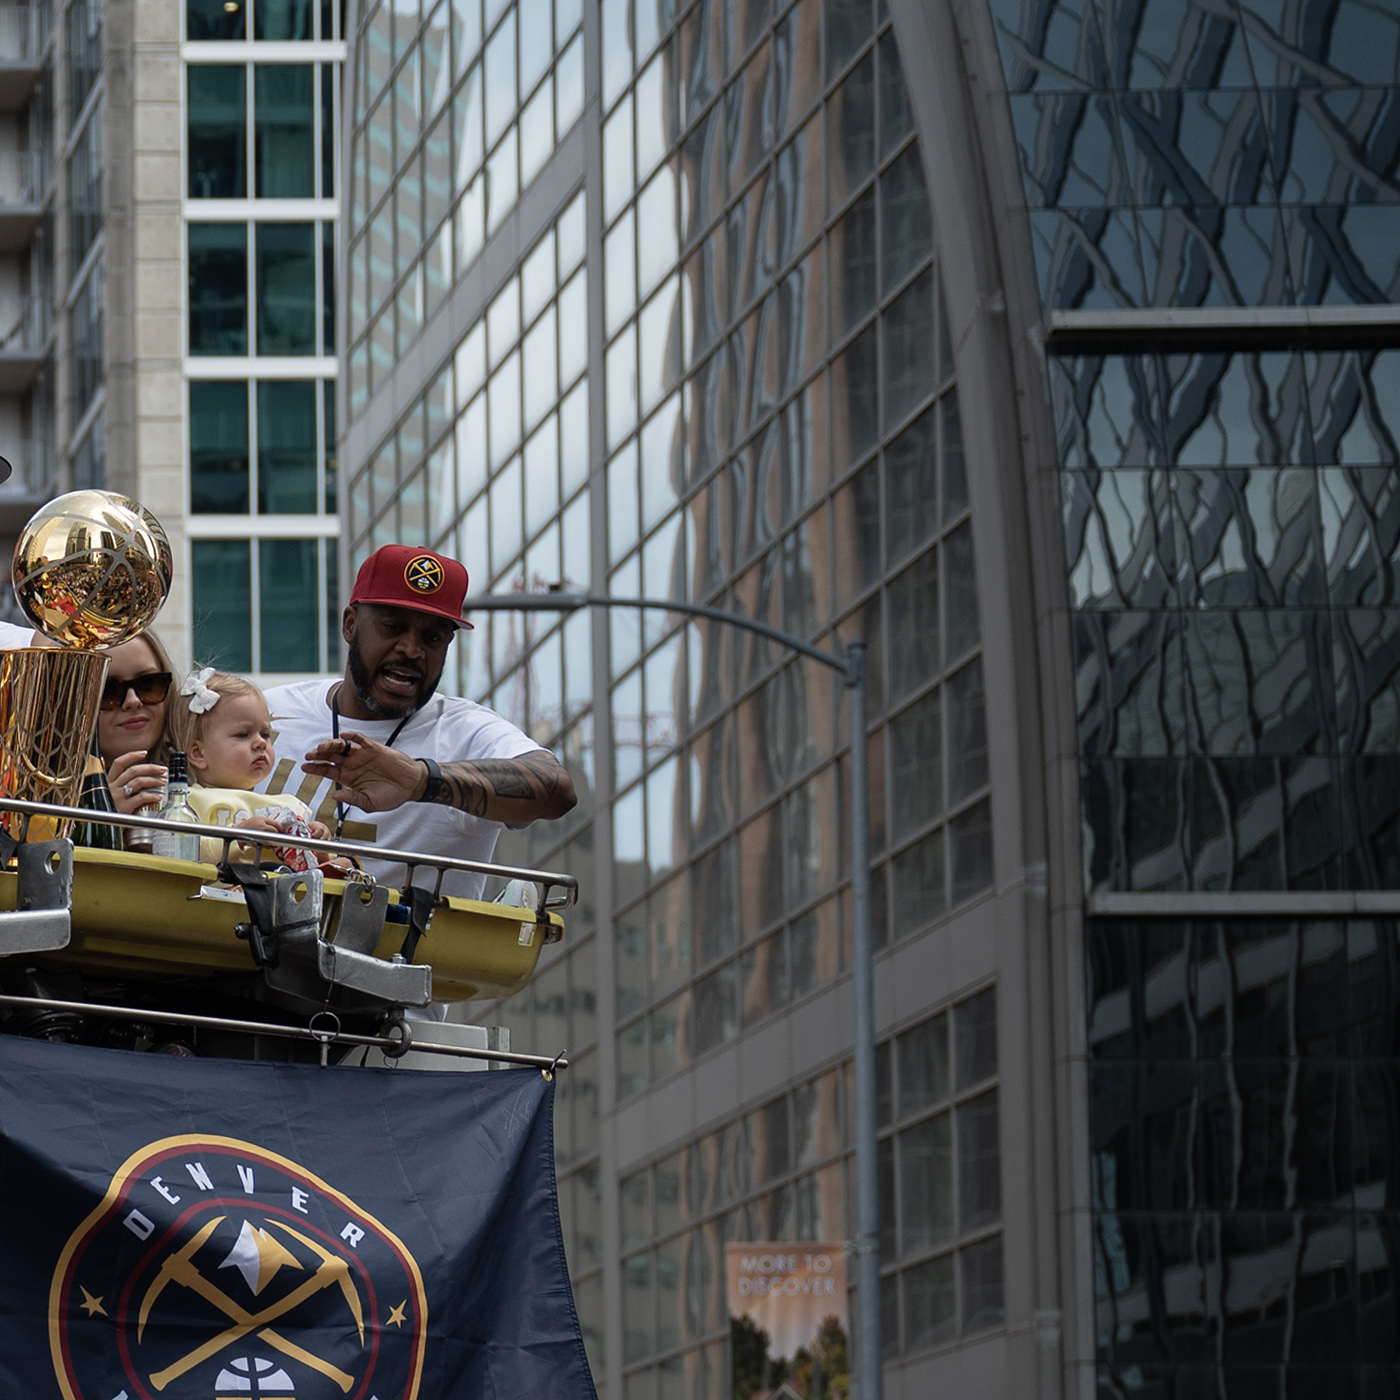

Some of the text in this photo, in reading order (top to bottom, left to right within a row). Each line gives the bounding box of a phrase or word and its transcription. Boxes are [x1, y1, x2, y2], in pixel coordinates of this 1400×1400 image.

[122, 1161, 366, 1249] DENVER
[741, 1253, 832, 1274] MORE TO
[738, 1276, 836, 1296] DISCOVER
